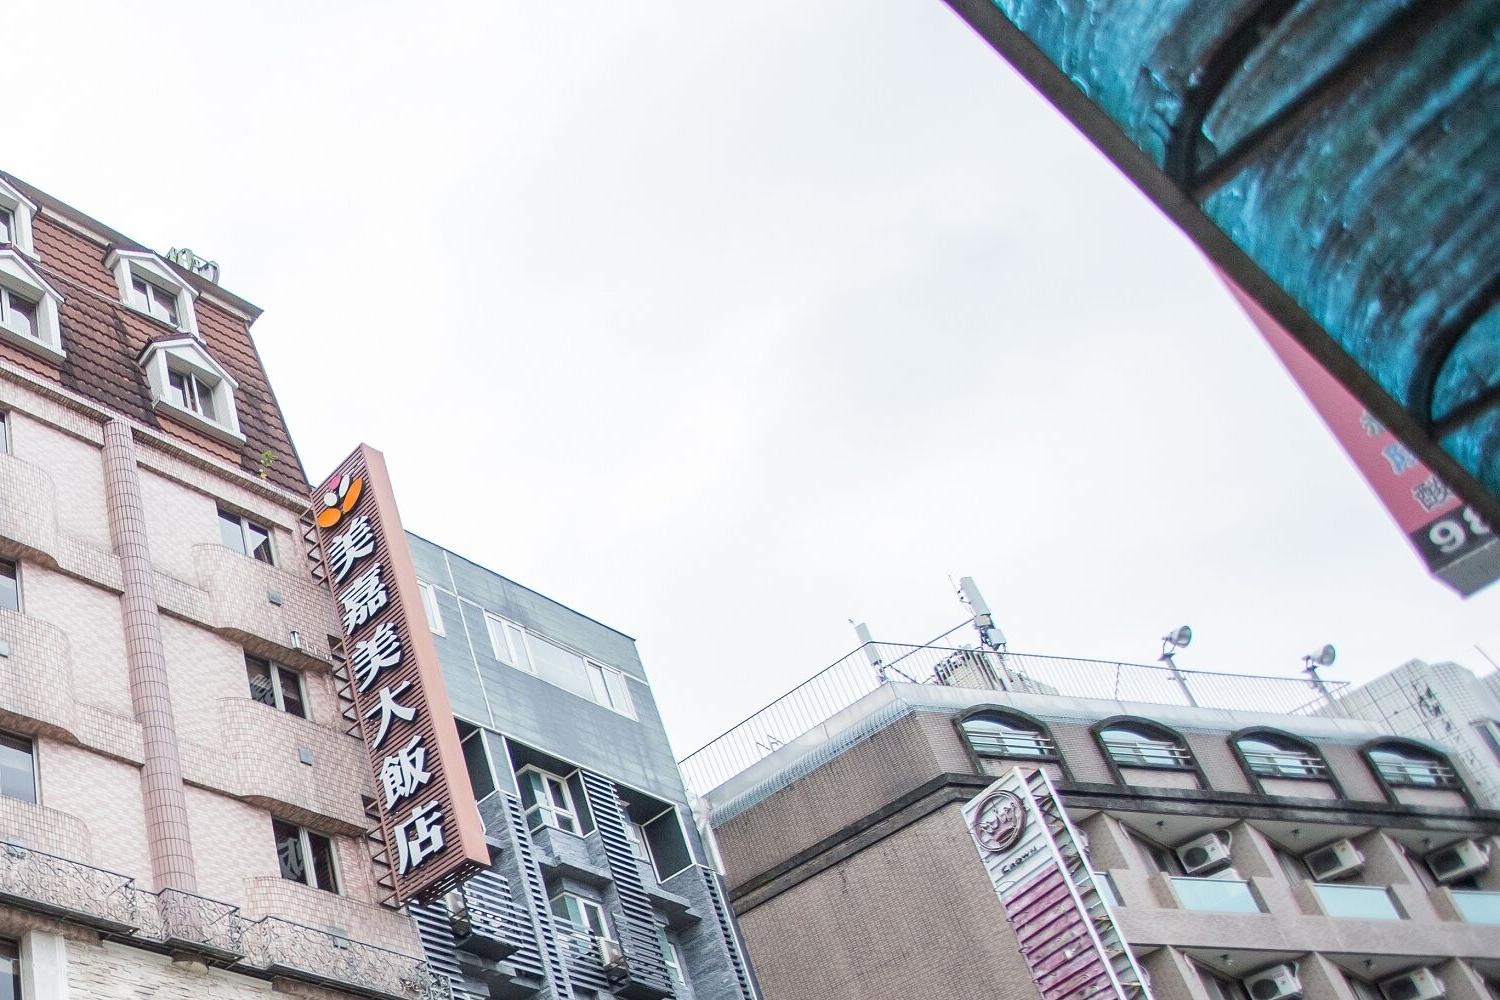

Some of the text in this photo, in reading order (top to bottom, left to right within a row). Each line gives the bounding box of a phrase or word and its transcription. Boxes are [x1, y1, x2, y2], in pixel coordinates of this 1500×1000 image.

[329, 515, 448, 877] 美嘉美大飯店
